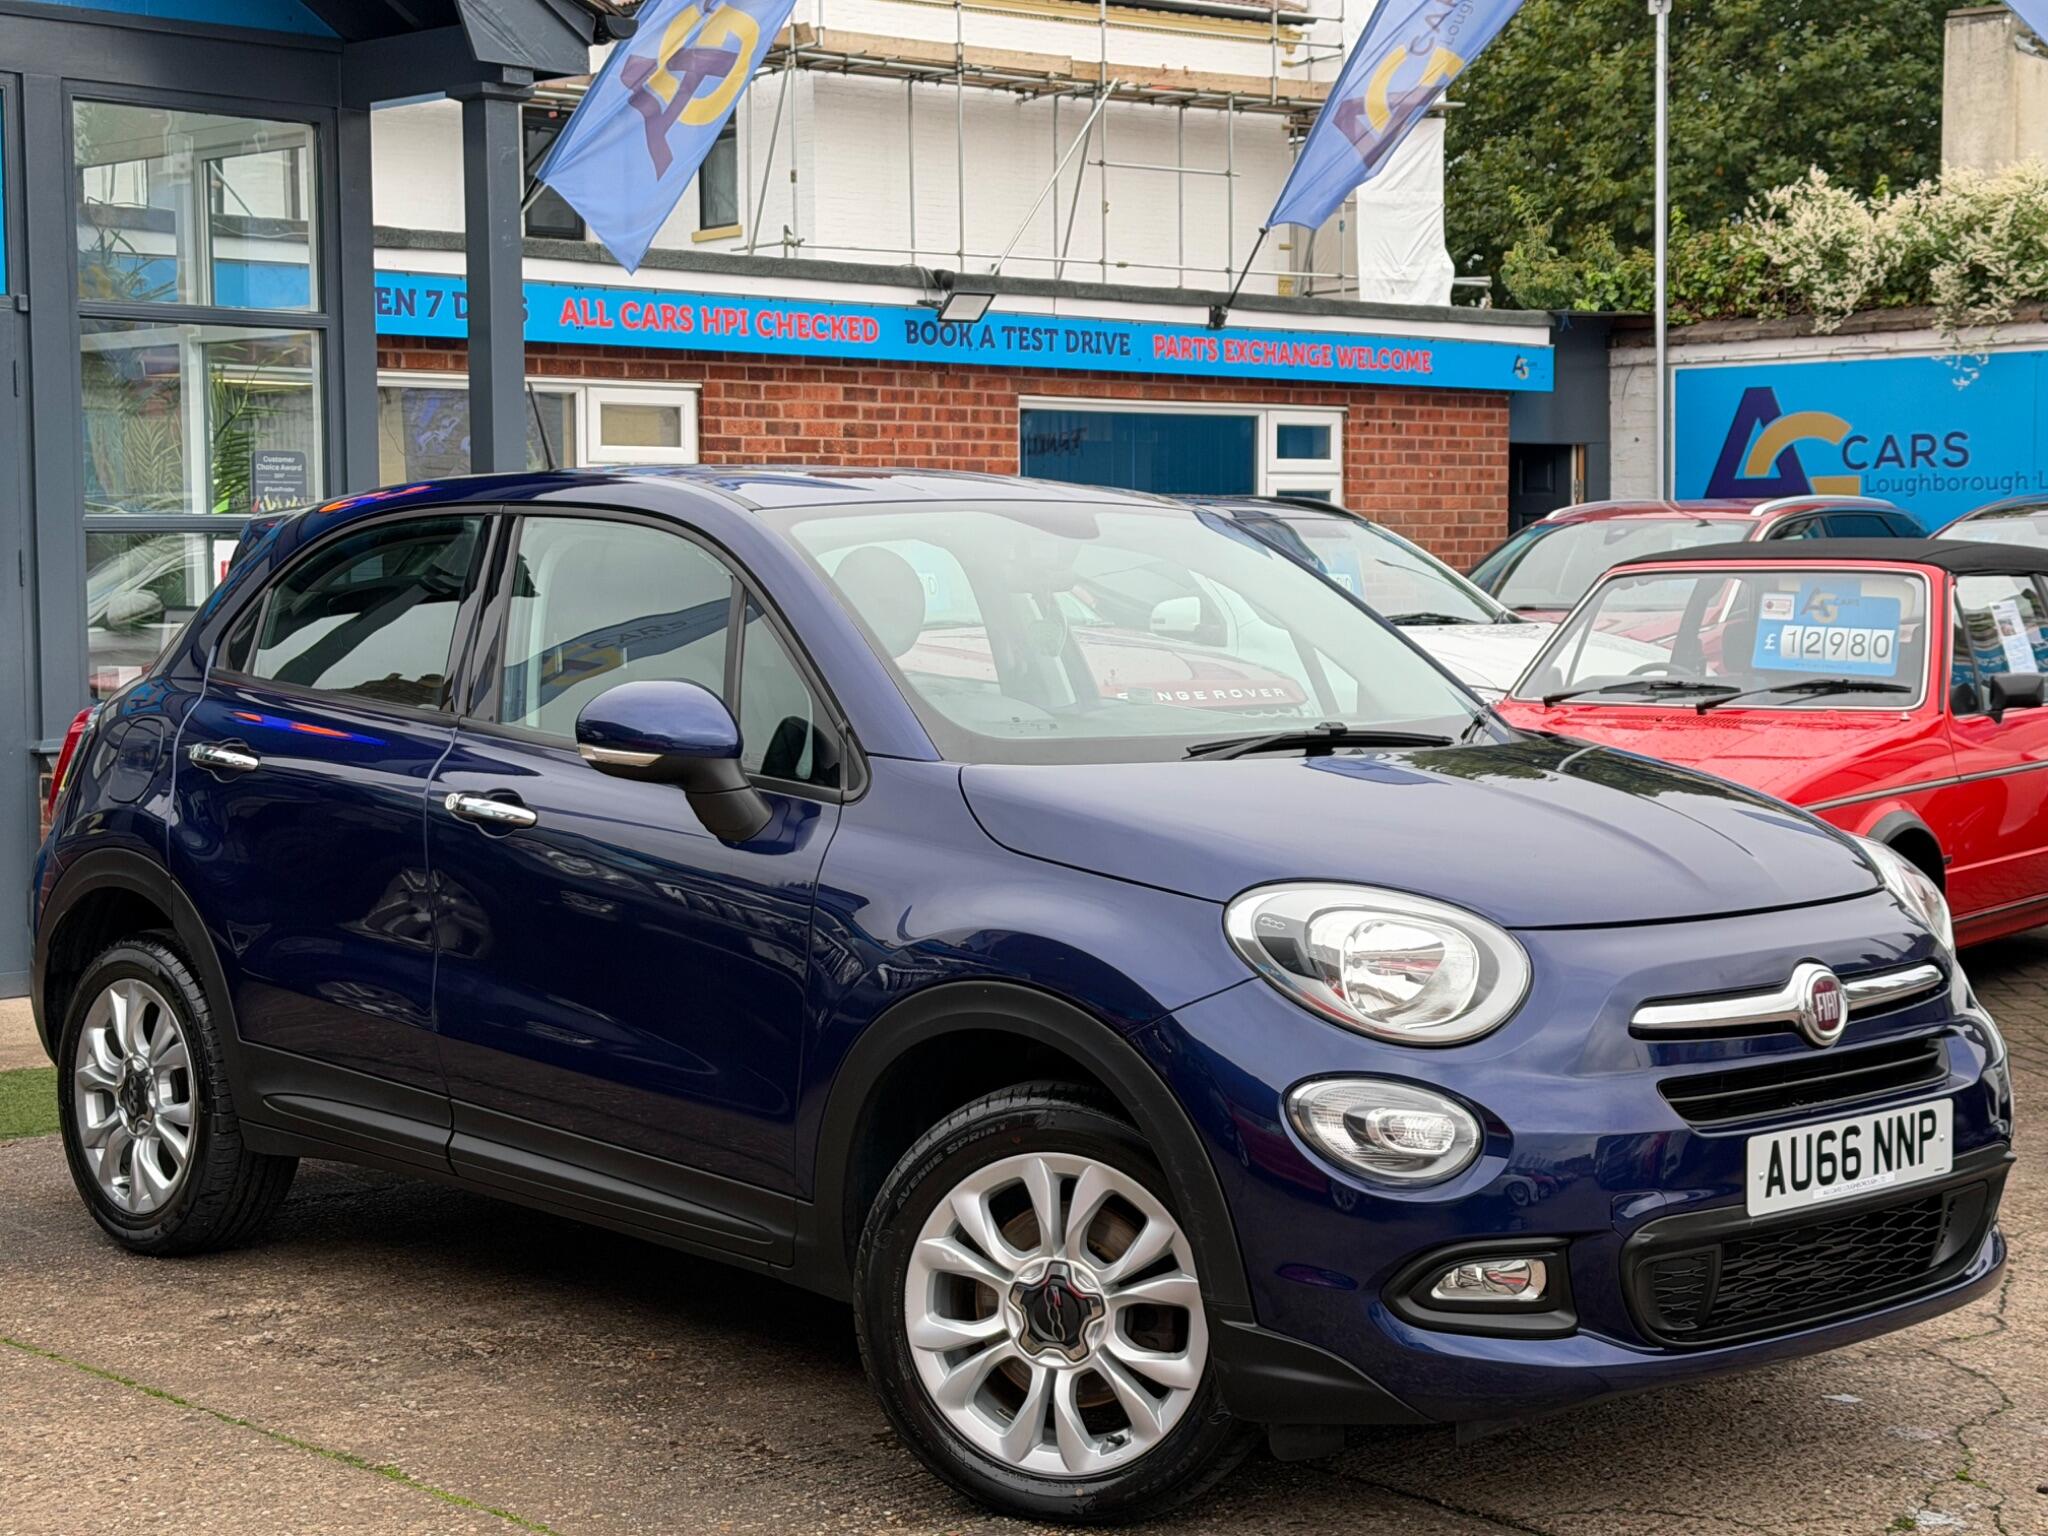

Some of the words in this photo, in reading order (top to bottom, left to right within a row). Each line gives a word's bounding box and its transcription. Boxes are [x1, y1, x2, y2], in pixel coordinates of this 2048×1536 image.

[426, 290, 443, 318] 7
[560, 298, 613, 327] ALL
[619, 303, 694, 333] CARS
[701, 307, 748, 336] HPI
[756, 311, 879, 344] CHECKED
[905, 319, 973, 348] BOOK
[979, 324, 996, 349] A
[1002, 325, 1059, 352] TEST
[1065, 330, 1131, 356] DRIVE
[1153, 335, 1218, 362] PARTS
[1223, 339, 1333, 369] EXCHANGE
[1335, 344, 1433, 373] WELCOME
[256, 463, 280, 471] Choice
[1842, 431, 1970, 470] CARS
[1865, 471, 2028, 496] Loughborough
[1212, 687, 1286, 700] ROVER
[1815, 990, 1839, 1021] FIAT
[1765, 1125, 1862, 1198] AU66
[1873, 1109, 1937, 1175] NNP
